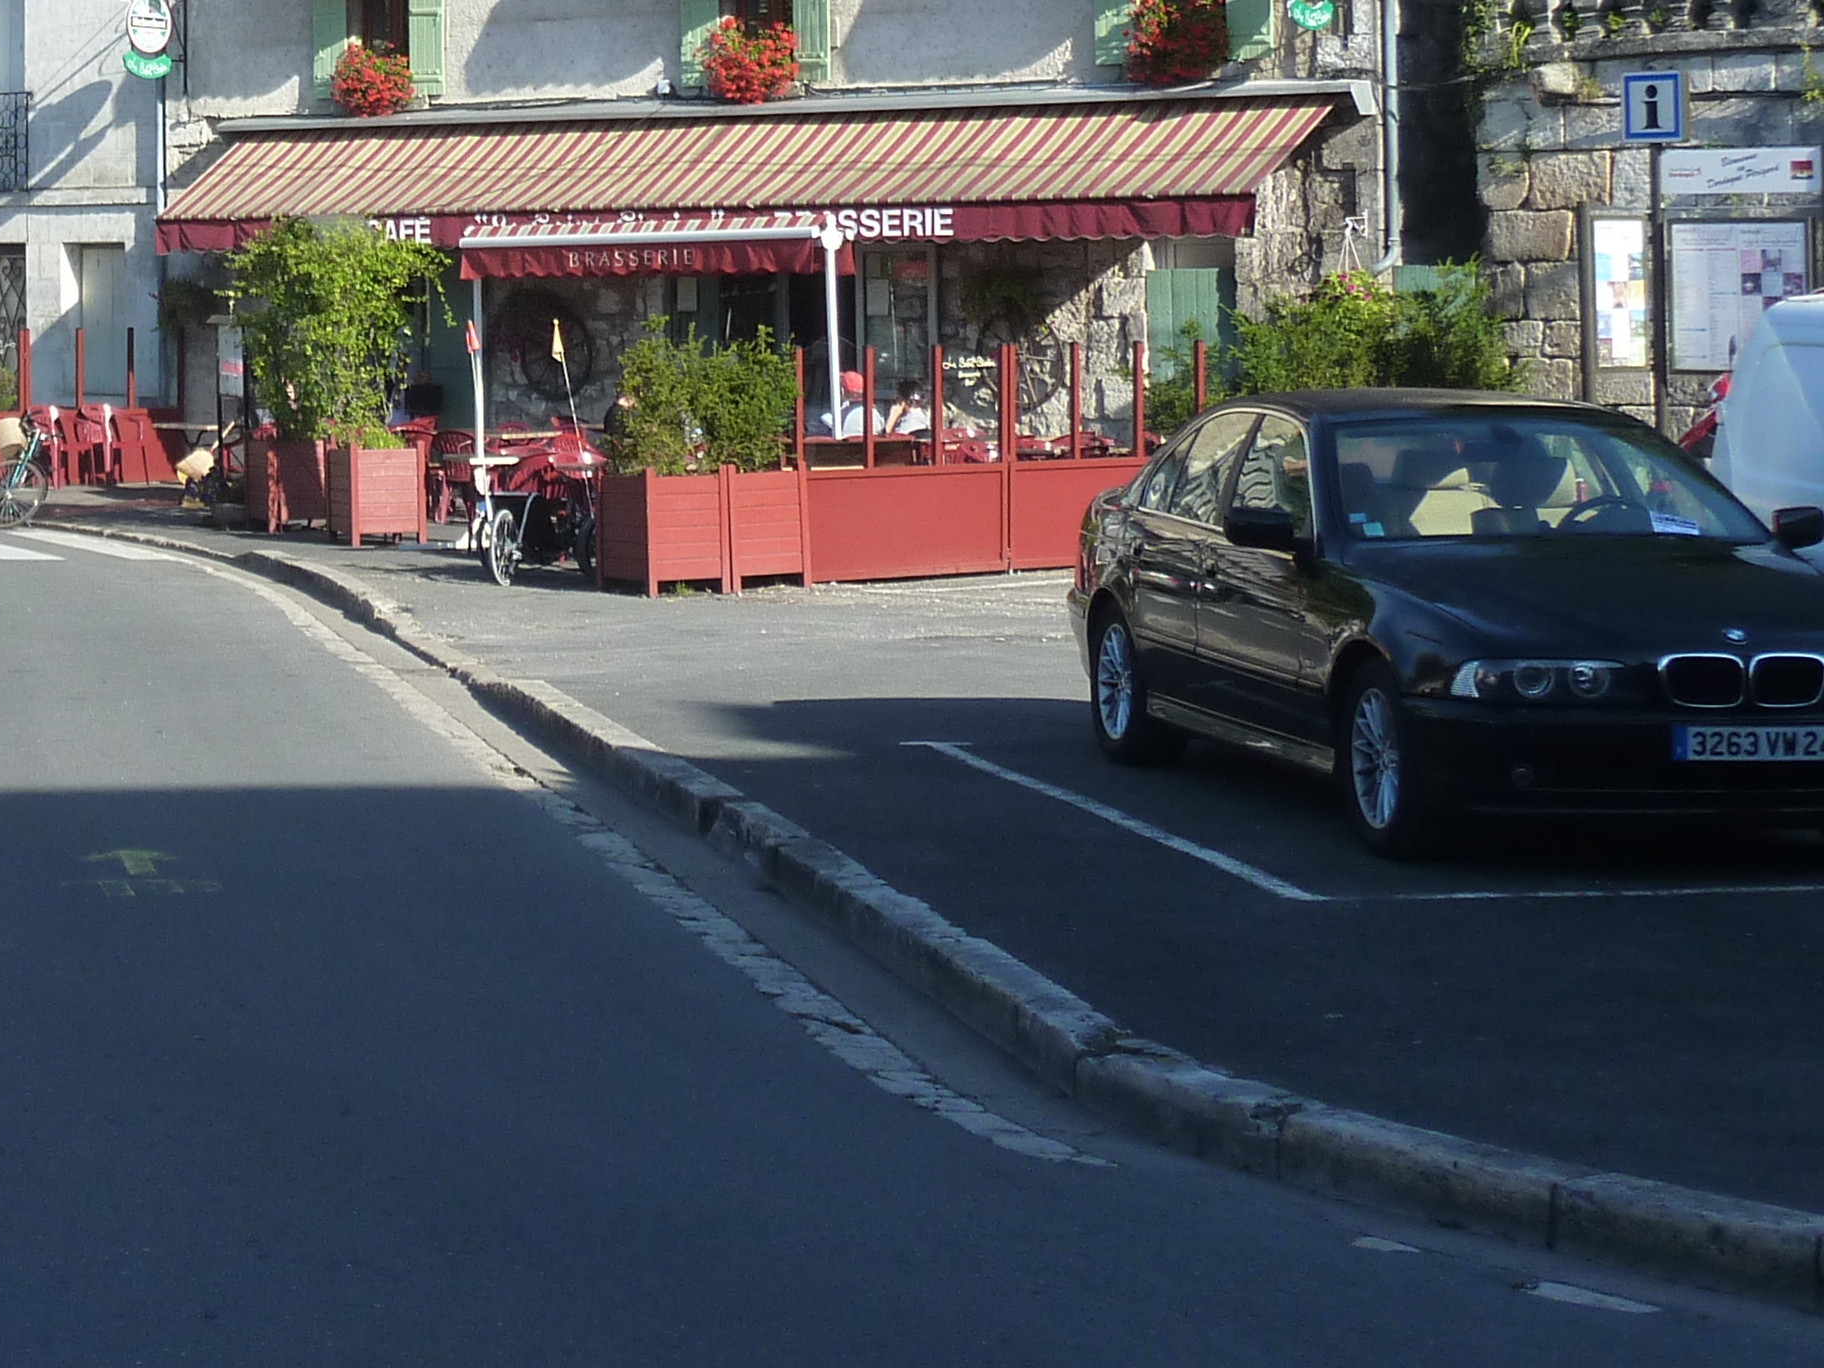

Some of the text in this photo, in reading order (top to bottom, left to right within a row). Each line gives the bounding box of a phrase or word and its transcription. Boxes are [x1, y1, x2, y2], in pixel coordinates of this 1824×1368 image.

[568, 247, 694, 269] BRASSERIE
[1691, 731, 1759, 757] 3263
[1766, 731, 1797, 757] VW
[1802, 731, 1824, 756] 2
